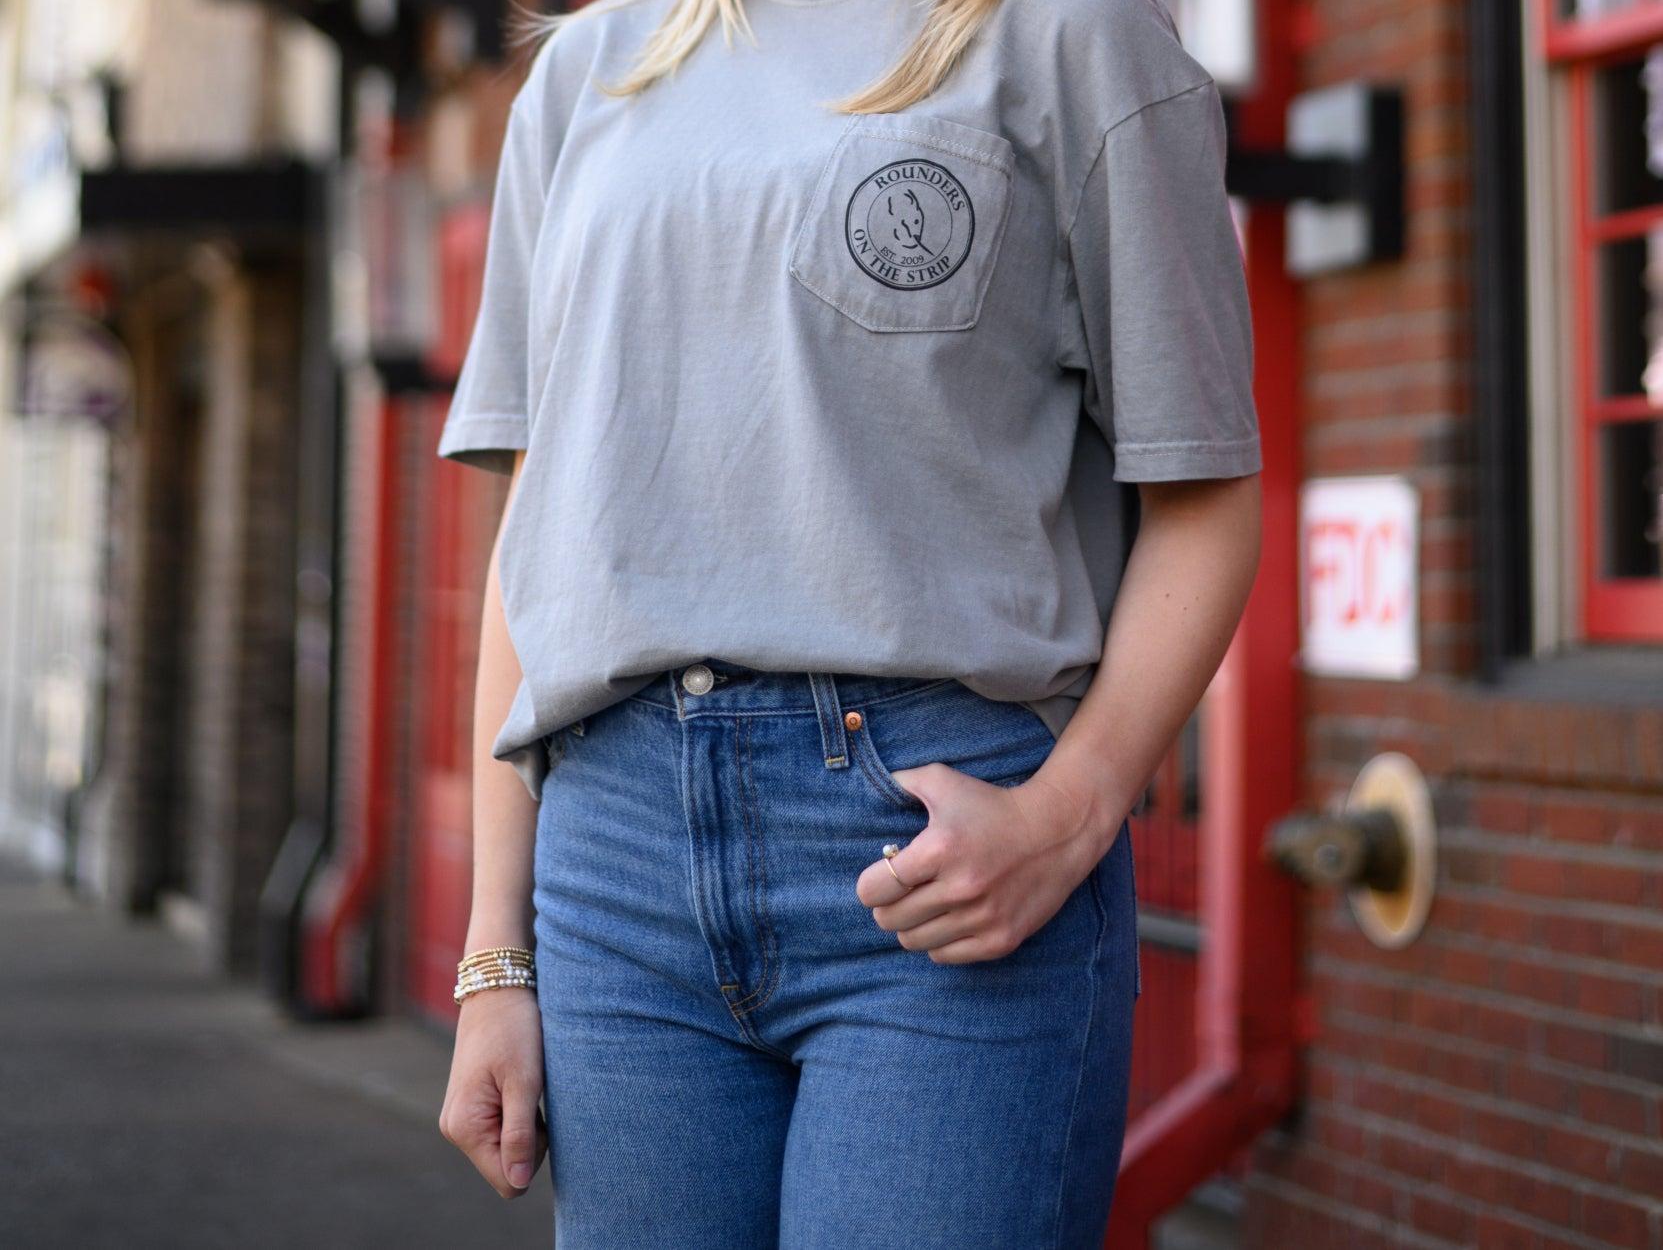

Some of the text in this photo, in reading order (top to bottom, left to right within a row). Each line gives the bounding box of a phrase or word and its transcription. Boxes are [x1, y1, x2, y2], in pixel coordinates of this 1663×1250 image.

[874, 165, 966, 212] ROUNDERS
[853, 228, 951, 283] ON THE STRIP
[880, 246, 925, 265] EST. 2009
